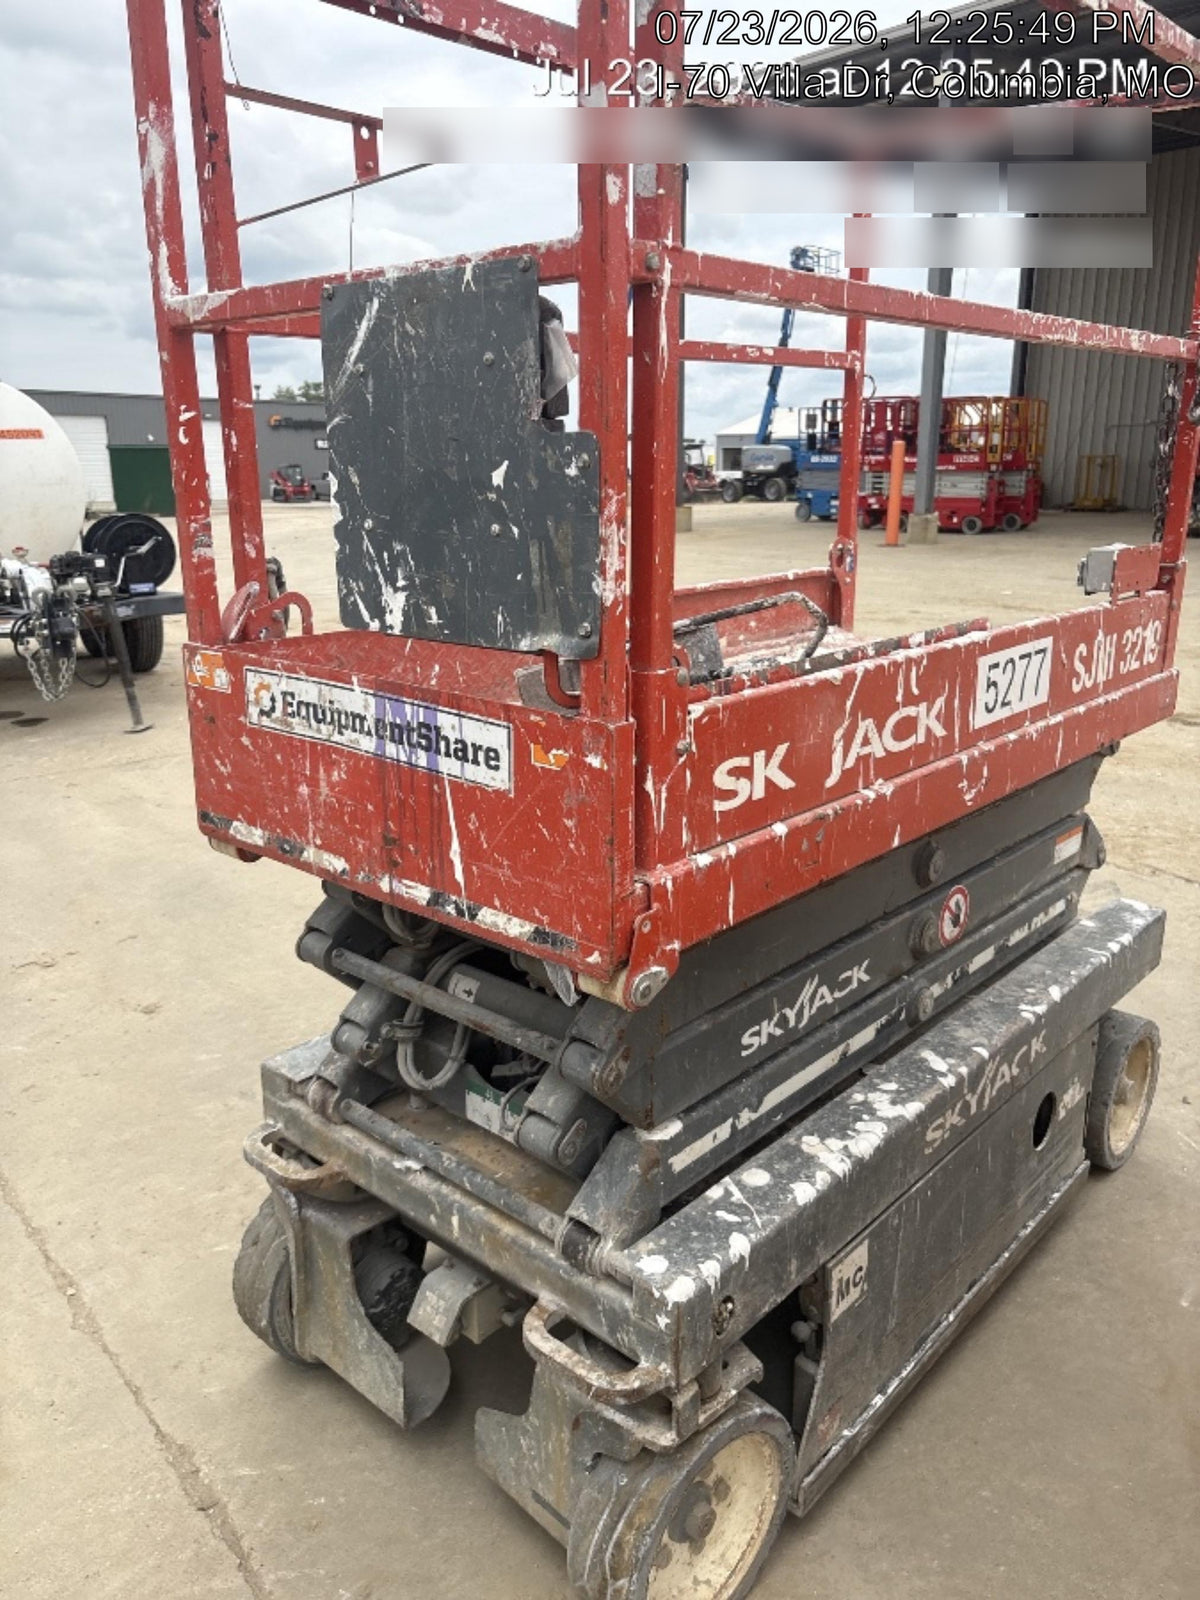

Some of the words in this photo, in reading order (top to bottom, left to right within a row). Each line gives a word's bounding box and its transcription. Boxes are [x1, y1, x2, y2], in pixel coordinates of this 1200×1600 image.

[984, 646, 1048, 714] 5277
[281, 689, 501, 772] EquipmentShare
[741, 958, 871, 1057] SKYJACK
[924, 1029, 1047, 1155] SKYJACK
